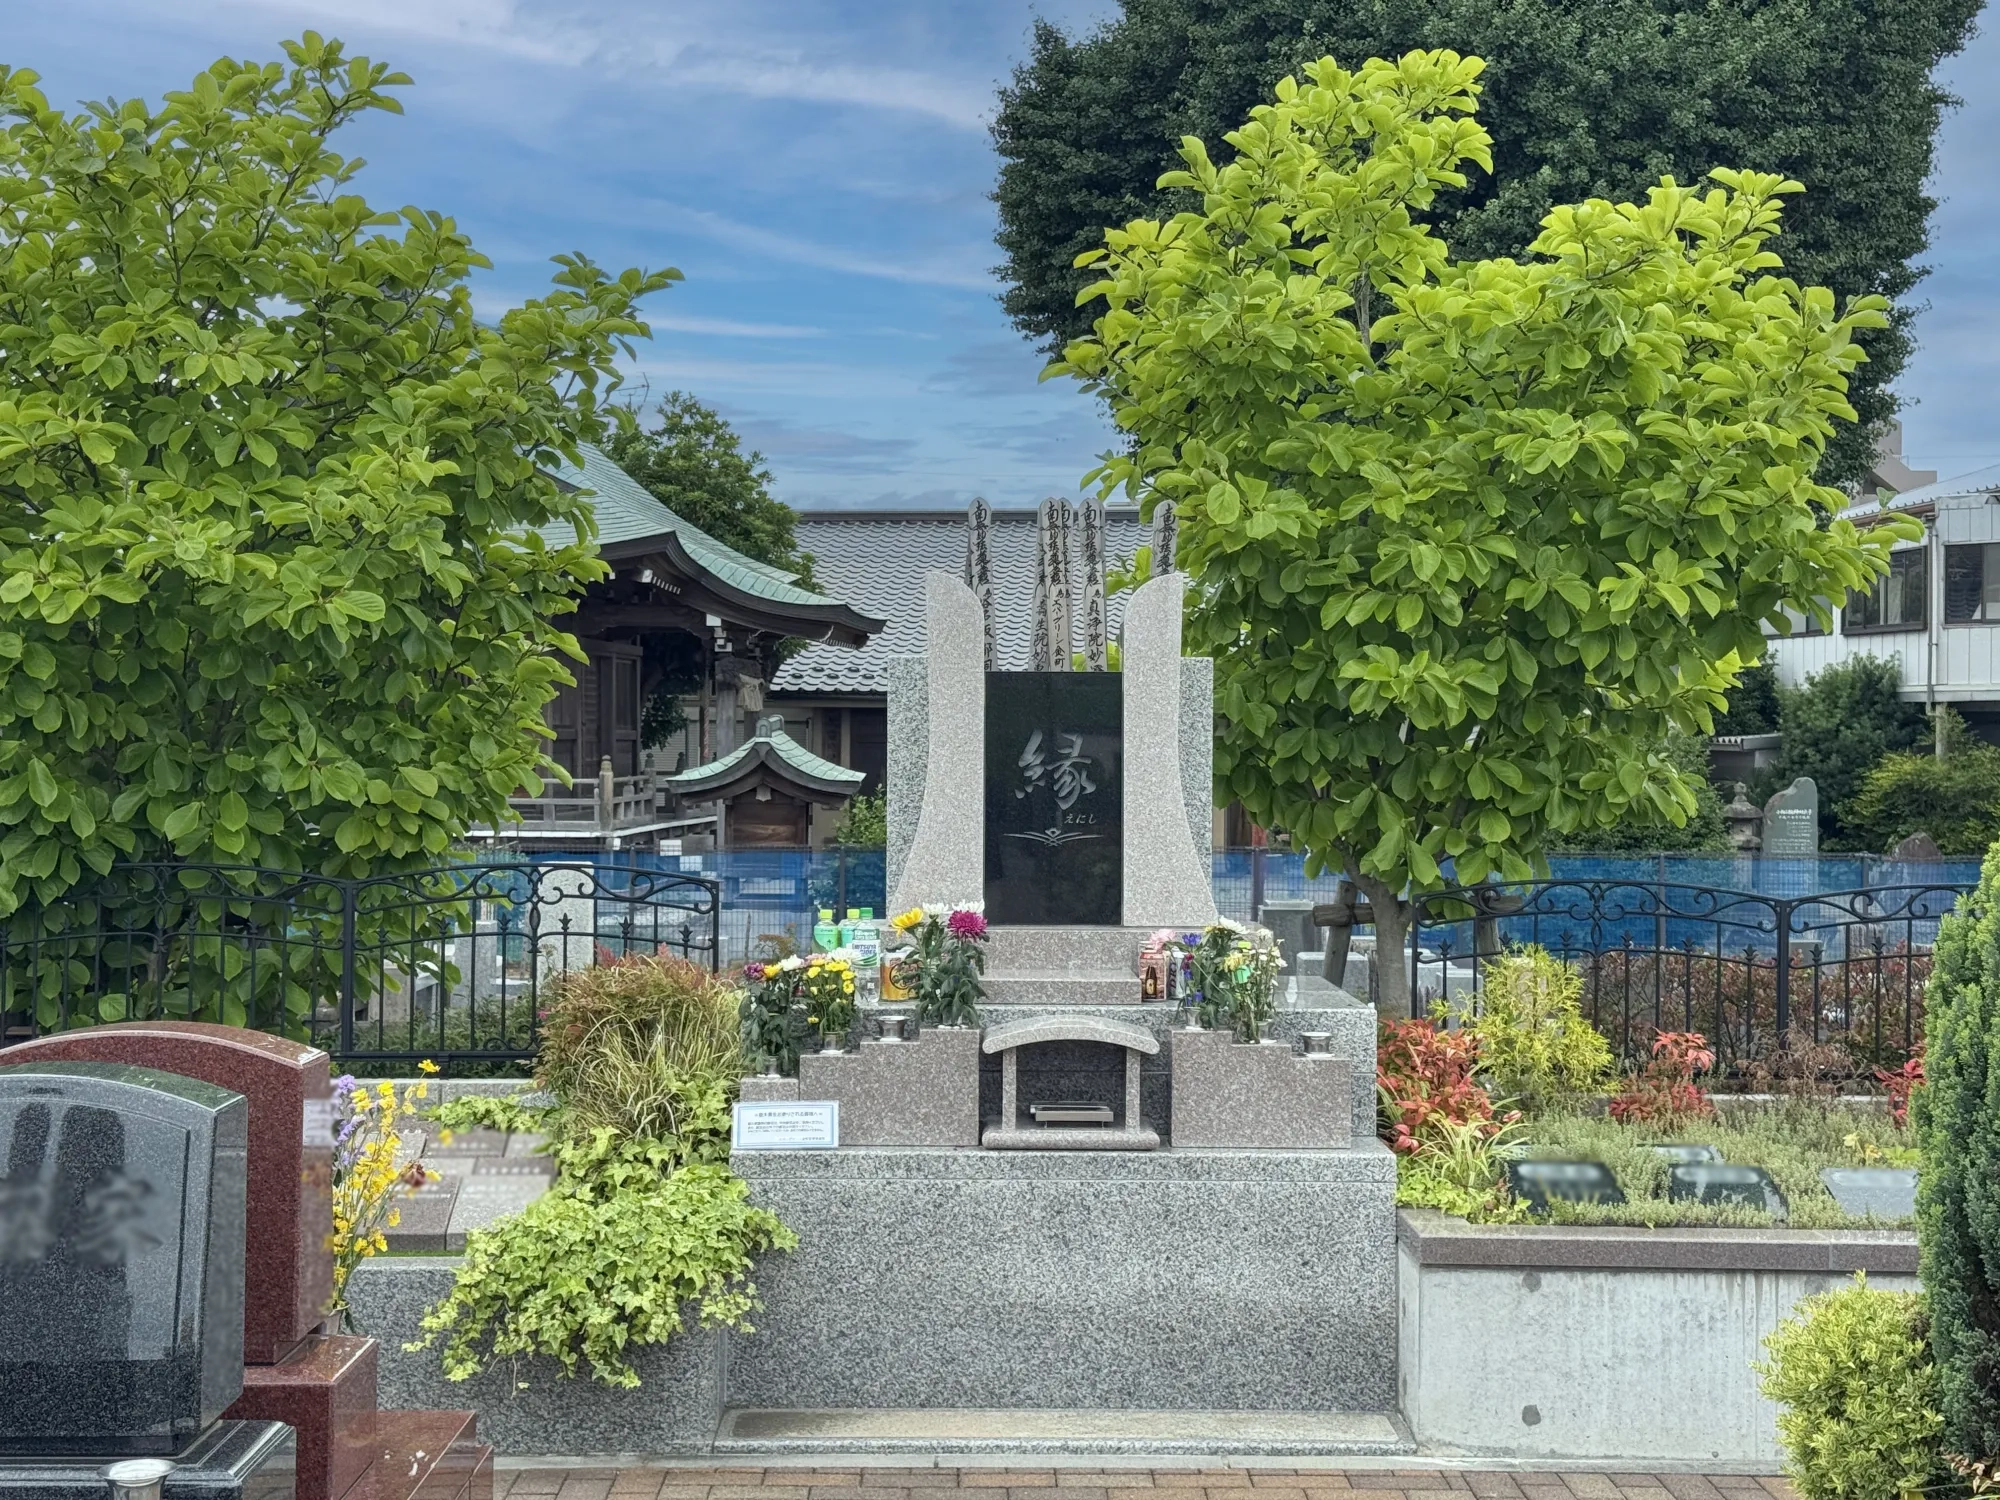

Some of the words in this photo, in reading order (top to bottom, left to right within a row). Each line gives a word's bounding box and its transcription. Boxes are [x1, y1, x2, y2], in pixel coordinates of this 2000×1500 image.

[1014, 728, 1097, 810] 縁
[1064, 813, 1097, 824] えにし
